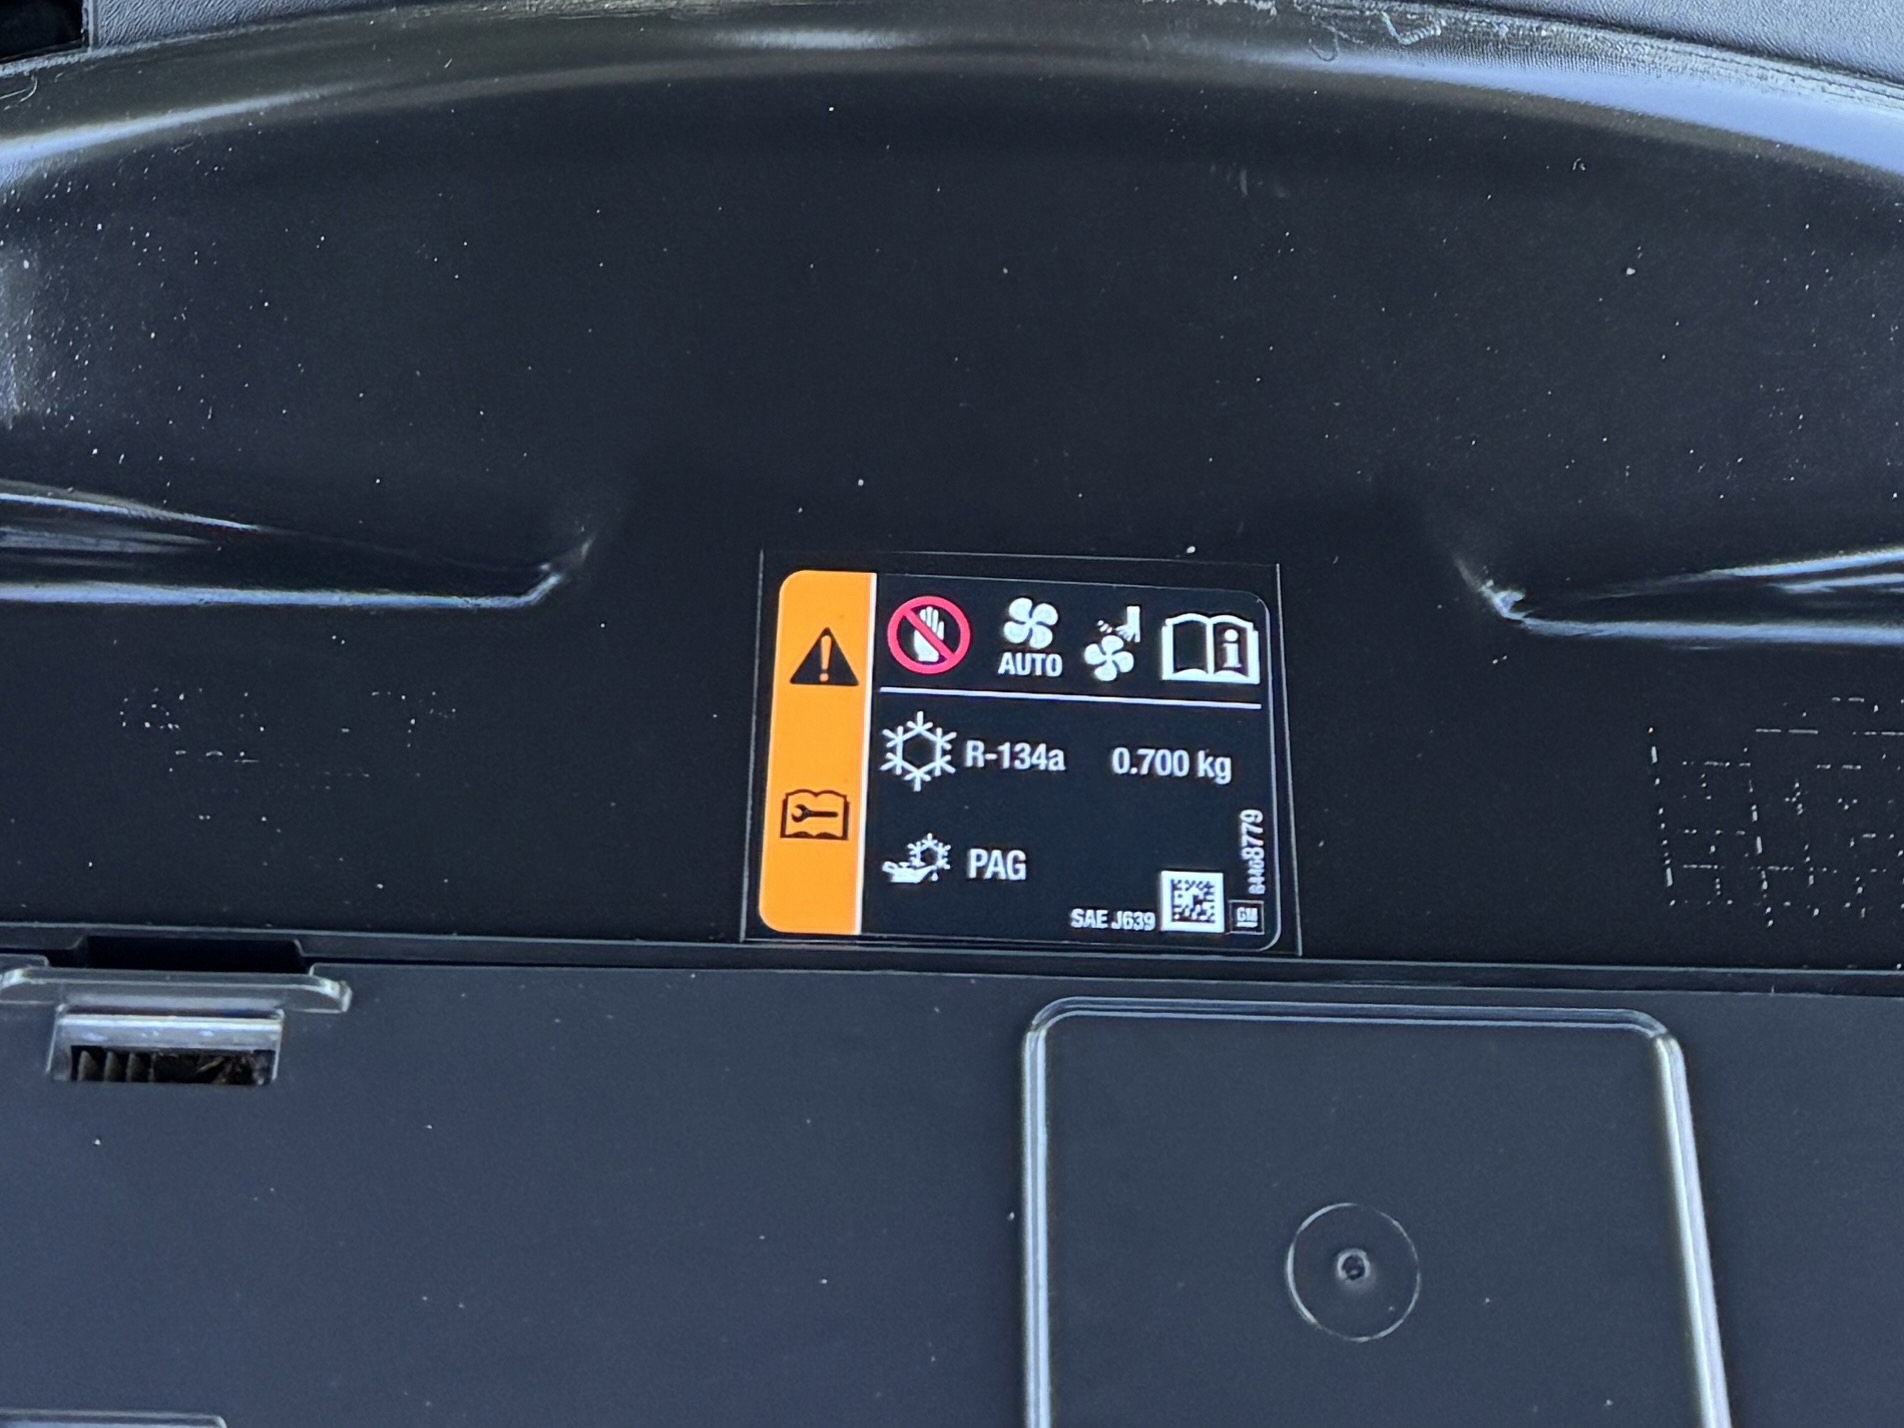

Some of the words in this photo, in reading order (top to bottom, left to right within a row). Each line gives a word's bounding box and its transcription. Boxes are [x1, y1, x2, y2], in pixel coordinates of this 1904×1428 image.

[997, 650, 1063, 678] AUTO
[964, 739, 1066, 773] R-134a
[1111, 747, 1190, 778] 0.700
[1196, 748, 1233, 785] kg
[969, 849, 1027, 882] PAG
[1070, 907, 1107, 931] SAE
[1111, 908, 1156, 933] J639
